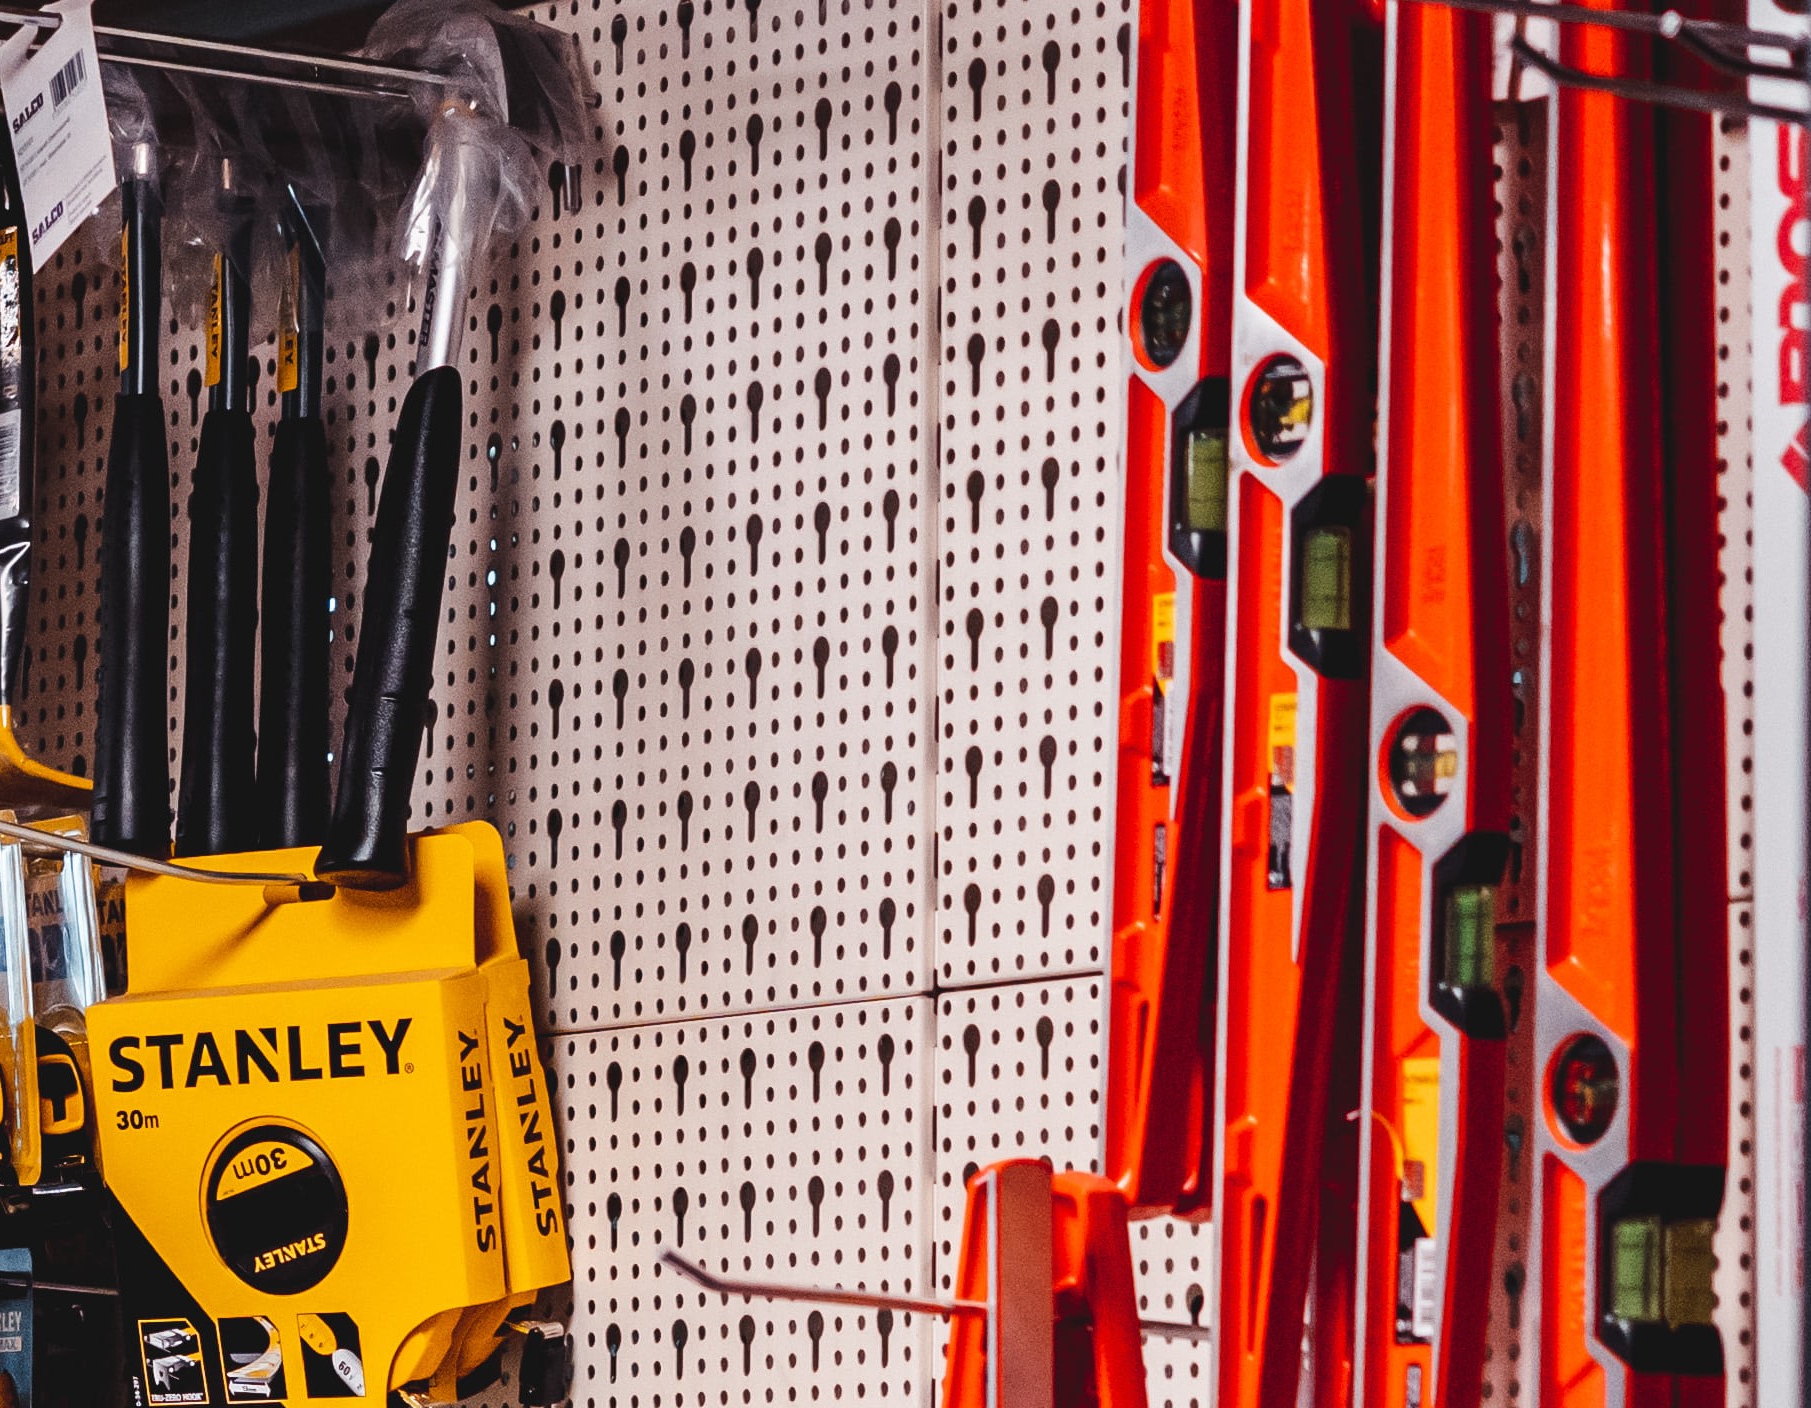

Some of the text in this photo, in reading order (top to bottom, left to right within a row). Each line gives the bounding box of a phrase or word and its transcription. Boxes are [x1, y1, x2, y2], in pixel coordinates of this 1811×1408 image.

[12, 92, 44, 134] SALCO
[32, 201, 64, 245] SALCO
[108, 1017, 413, 1094] STANLEY
[116, 1110, 160, 1130] 30m
[458, 1029, 497, 1254] STANLEY
[504, 1014, 559, 1238] STANLEY
[233, 1147, 288, 1181] 30m
[253, 1232, 327, 1274] STANLEY
